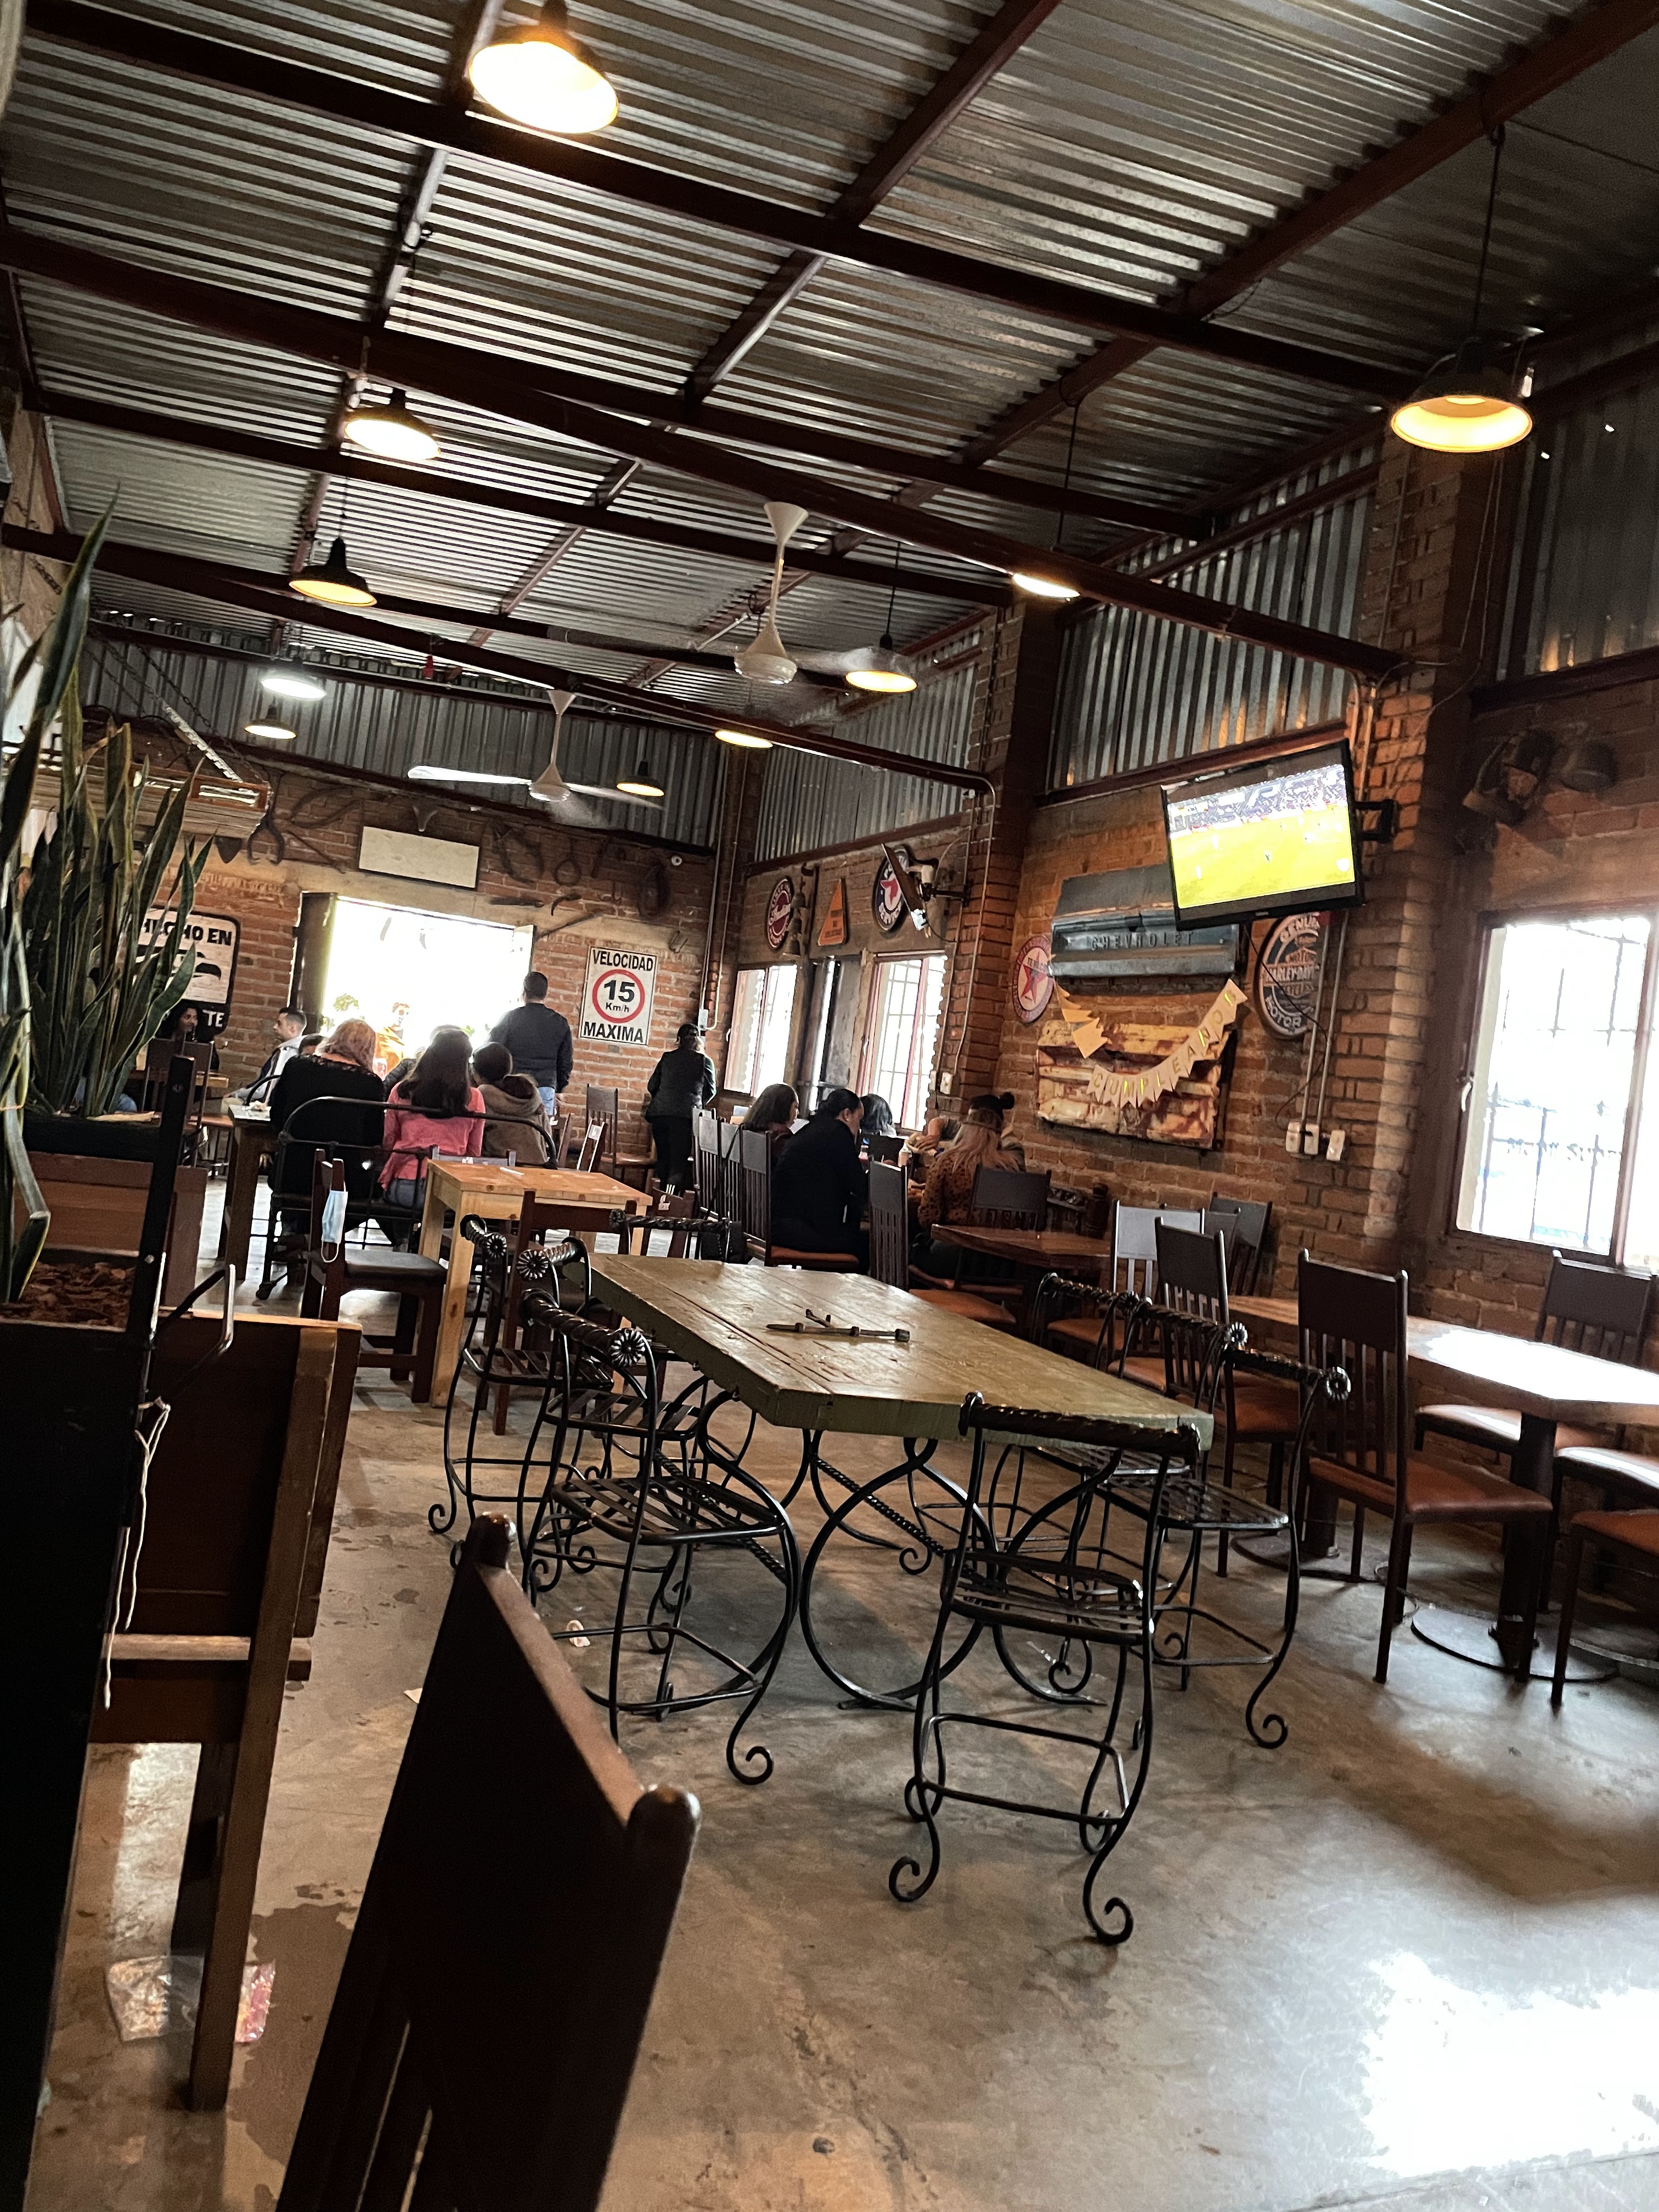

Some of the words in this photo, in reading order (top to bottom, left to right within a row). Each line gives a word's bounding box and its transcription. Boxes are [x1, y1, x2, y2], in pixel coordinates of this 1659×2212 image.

[207, 928, 232, 946] EN
[1091, 932, 1193, 951] CHEVROLET
[593, 950, 653, 971] VELOCIDAD
[603, 980, 635, 1003] 15
[605, 1002, 629, 1012] Km/h
[583, 1022, 644, 1043] MAXIMA
